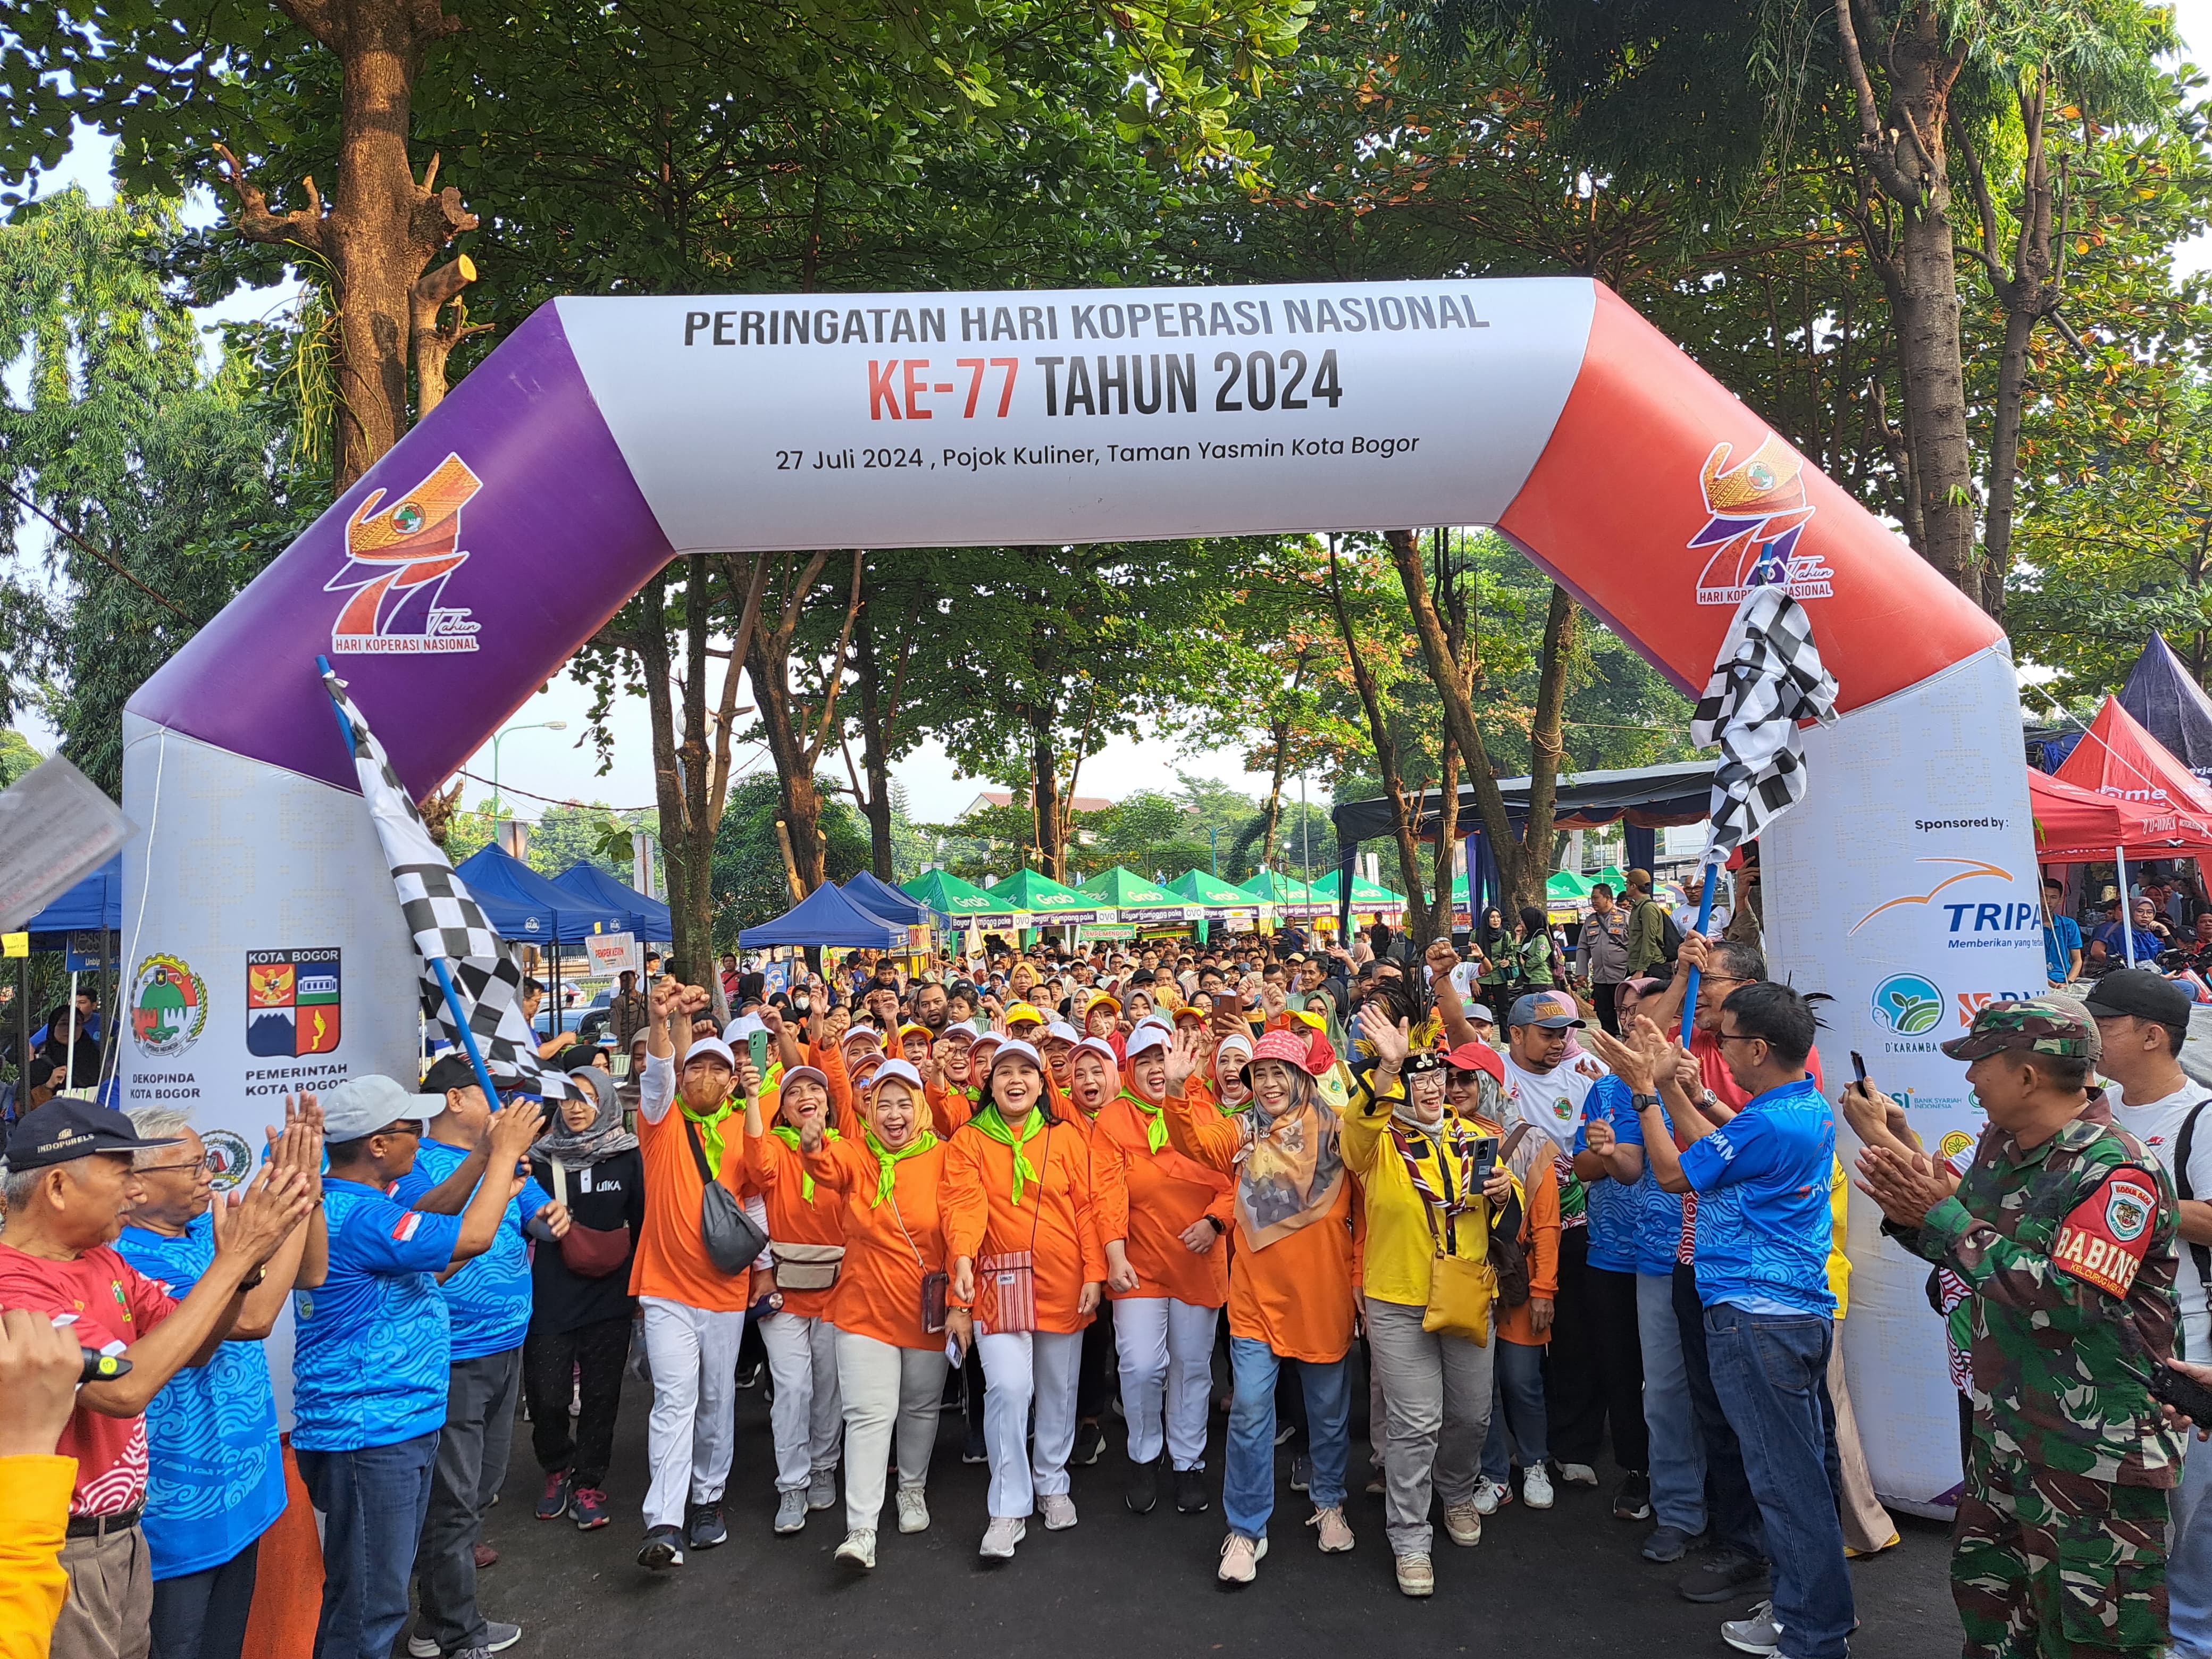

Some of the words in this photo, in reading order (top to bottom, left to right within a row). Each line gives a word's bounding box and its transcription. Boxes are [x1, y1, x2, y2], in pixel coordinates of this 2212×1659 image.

[684, 307, 946, 347] PERINGATAN
[961, 305, 1058, 342] HARI
[1070, 300, 1273, 340] KOPERASI
[1282, 294, 1490, 334] NASIONAL
[867, 357, 1019, 421] KE-77
[1035, 353, 1197, 417] TAHUN
[1213, 349, 1343, 412] 2024
[775, 450, 803, 470] 27
[812, 448, 855, 470] Juli
[862, 447, 924, 468] 2024
[943, 446, 1007, 472] Pojok
[1013, 445, 1100, 466] Kuliner,
[1107, 442, 1191, 463] Taman
[1197, 441, 1285, 459] Yasmin
[1291, 438, 1345, 457] Kota
[1351, 435, 1420, 458] Bogor
[1699, 591, 1723, 602] HARI
[1781, 583, 1831, 597] NASIONAL
[420, 610, 479, 637] Tahun
[336, 639, 362, 651] HARI
[365, 639, 420, 651] KOPERASI
[423, 638, 477, 650] NASIONAL
[1914, 817, 1989, 833] Sponsored
[1991, 817, 2009, 831] by:
[952, 895, 991, 908] Grab
[1036, 892, 1076, 905] Grab
[1127, 890, 1164, 902] Grab
[1205, 890, 1241, 901] Grab
[1367, 903, 1388, 912] gampang
[1030, 915, 1049, 924] Bayar
[1080, 912, 1094, 922] pake
[1099, 912, 1116, 921] OVO
[1121, 912, 1139, 921] Bayar
[1139, 911, 1167, 920] gampang
[1168, 909, 1183, 918] pake
[1186, 908, 1202, 917] OVO
[1943, 902, 2043, 932] TRIPA
[953, 919, 970, 928] Bayar
[998, 916, 1011, 926] pake
[1015, 916, 1030, 925] OVO
[1948, 938, 2012, 949] Memberikan
[2014, 939, 2031, 949] yang
[248, 952, 286, 963] KOTA
[292, 950, 339, 962] BOGOR
[1885, 1042, 1938, 1053] D'KARAMBA
[245, 1063, 347, 1080] PEMERINTAH
[132, 1073, 196, 1084] DEKOPINDA
[130, 1088, 152, 1099] KOTA
[155, 1087, 201, 1099] BOGOR
[245, 1084, 289, 1096] KOTA
[1890, 1092, 1911, 1109] SI
